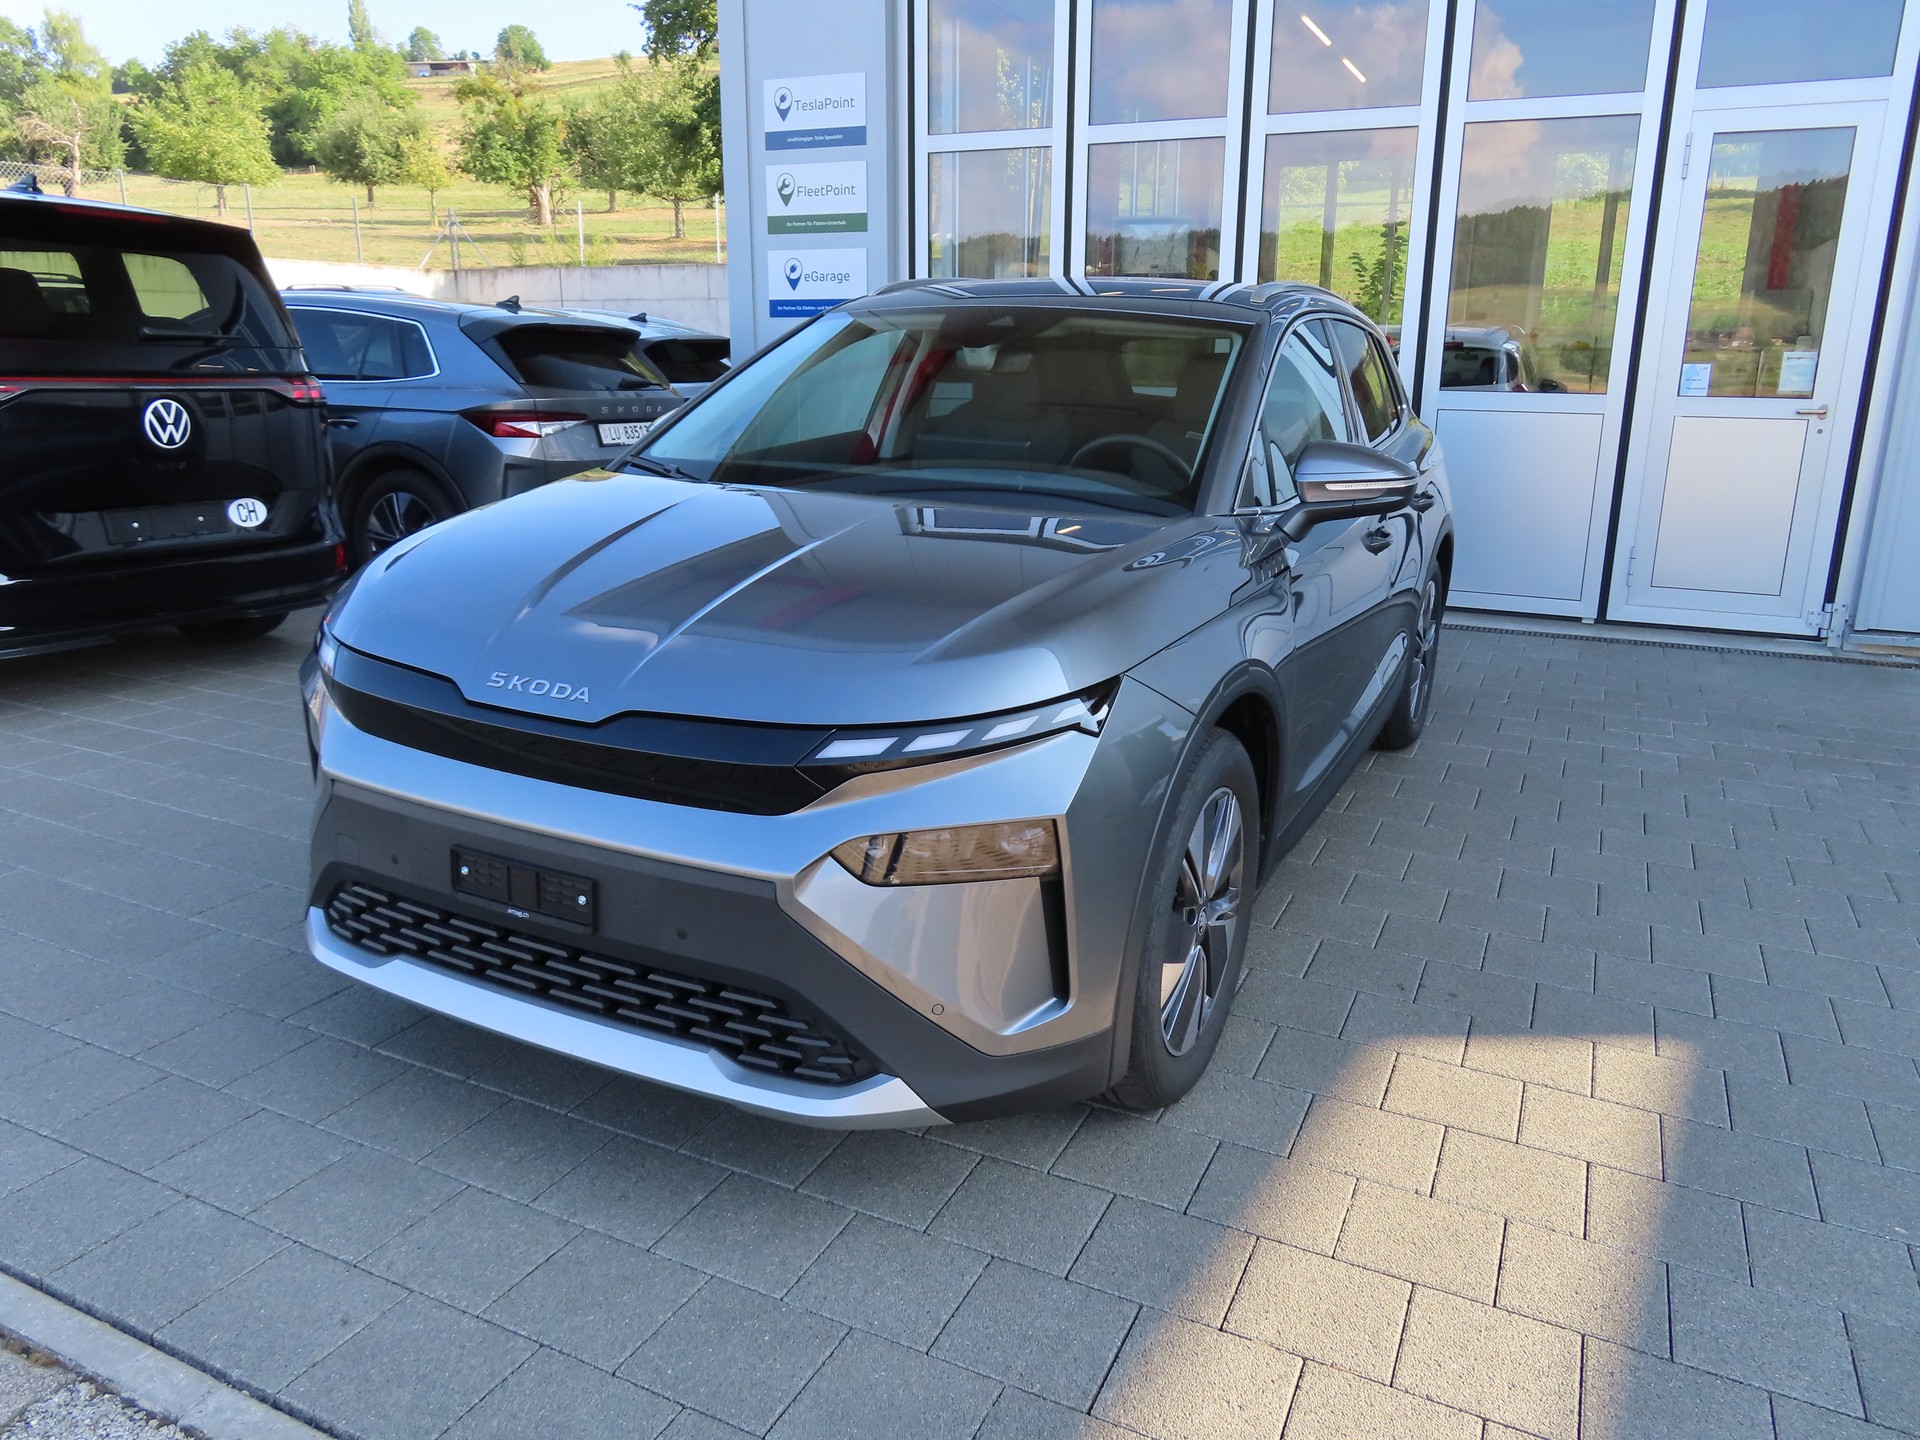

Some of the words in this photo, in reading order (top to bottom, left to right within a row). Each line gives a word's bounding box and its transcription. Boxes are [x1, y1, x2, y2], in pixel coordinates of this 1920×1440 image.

[794, 97, 855, 111] TeslaPoint
[797, 184, 856, 197] FleetPoint
[804, 271, 850, 284] eGarage
[236, 501, 259, 523] CH
[486, 671, 590, 704] SKODA
